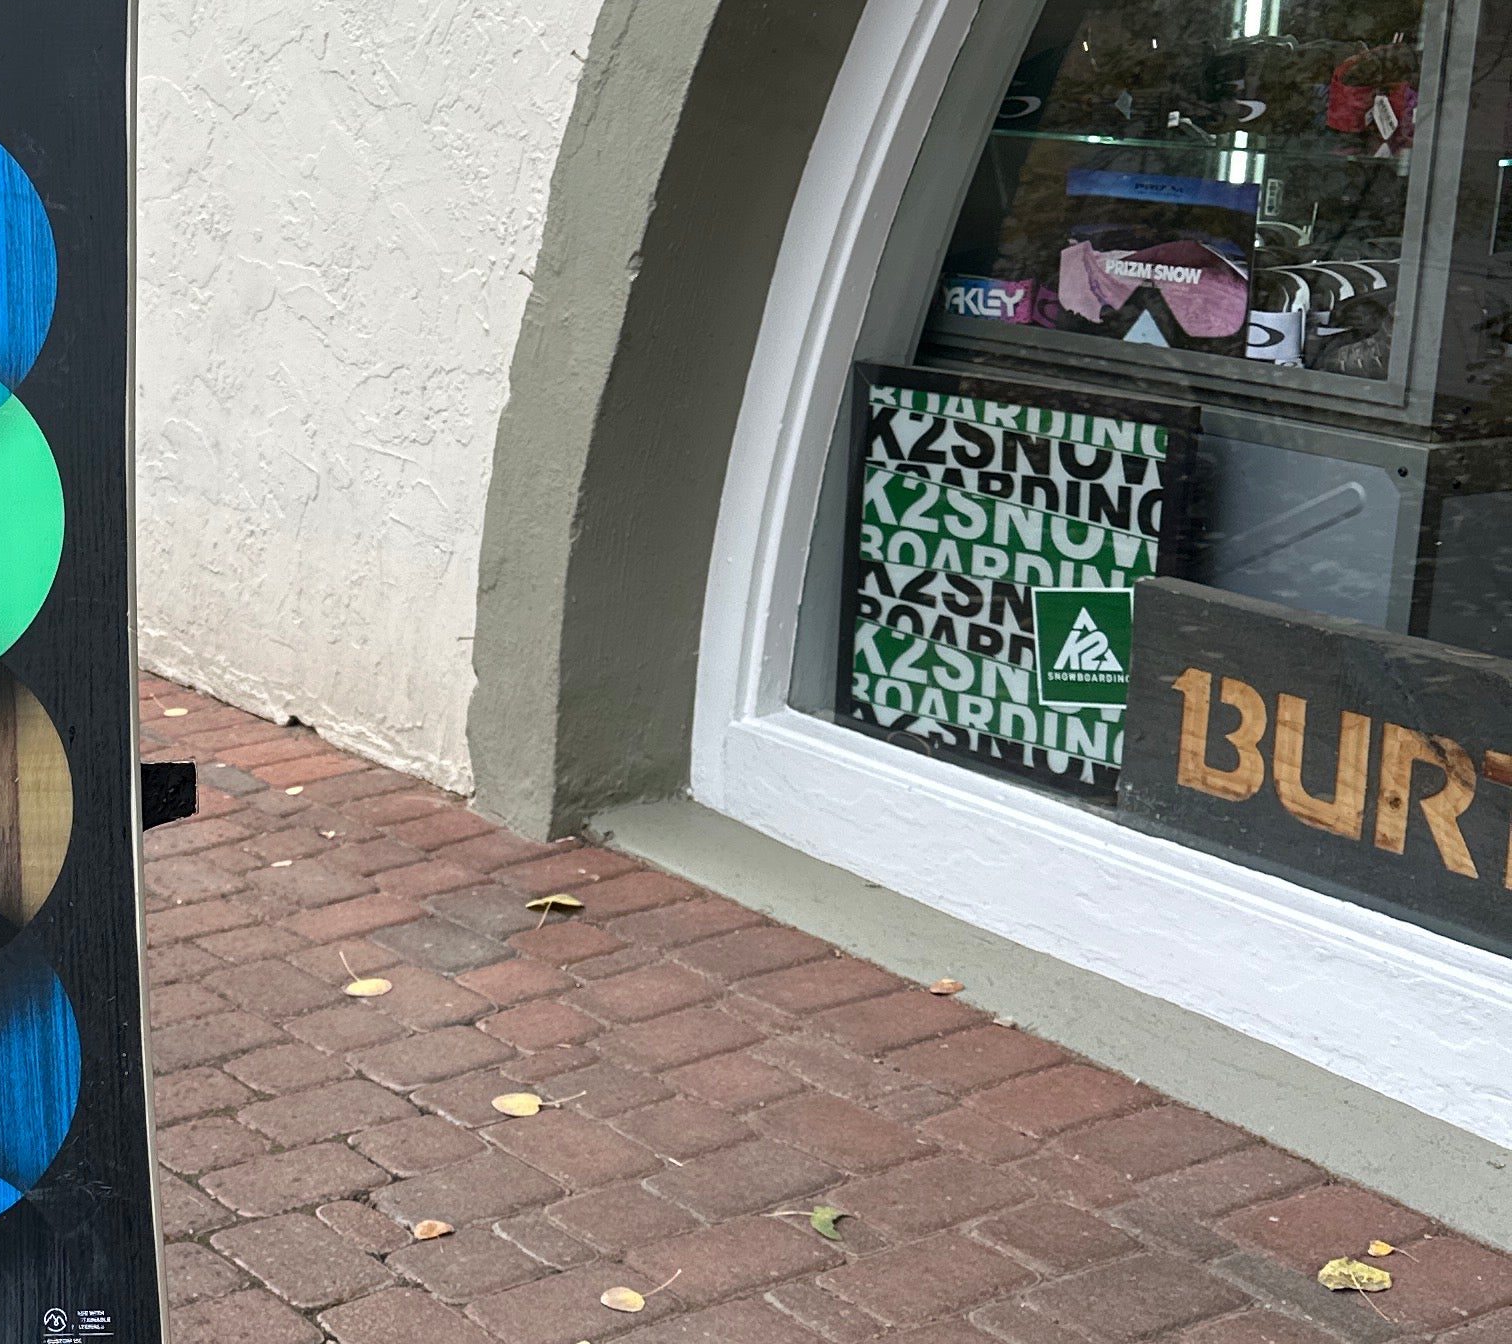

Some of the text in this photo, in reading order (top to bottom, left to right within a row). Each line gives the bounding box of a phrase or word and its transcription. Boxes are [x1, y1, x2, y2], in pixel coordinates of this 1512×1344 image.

[1105, 259, 1202, 285] PRIZM SNOW
[944, 286, 1025, 318] AKLEY
[1053, 629, 1109, 671] K2
